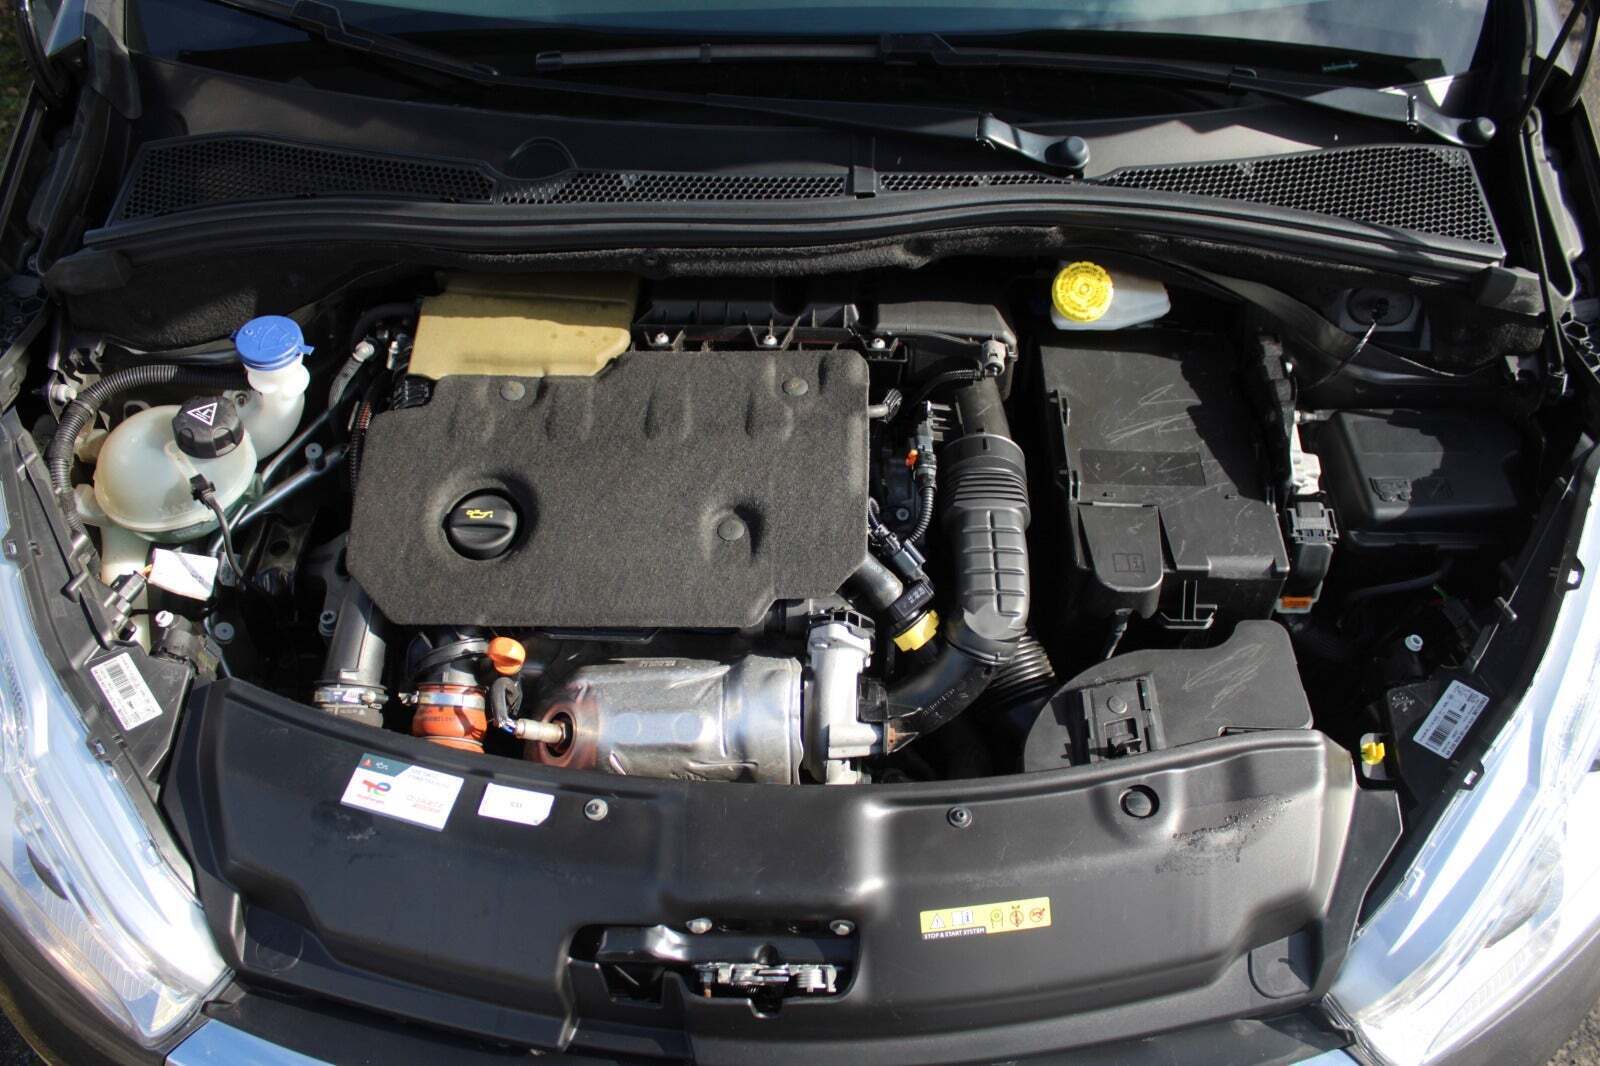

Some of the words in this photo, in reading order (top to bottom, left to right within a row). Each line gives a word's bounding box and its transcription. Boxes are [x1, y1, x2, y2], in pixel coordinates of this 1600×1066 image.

[923, 932, 940, 940] STOP
[945, 930, 962, 938] START
[963, 928, 985, 936] SYSTEM
